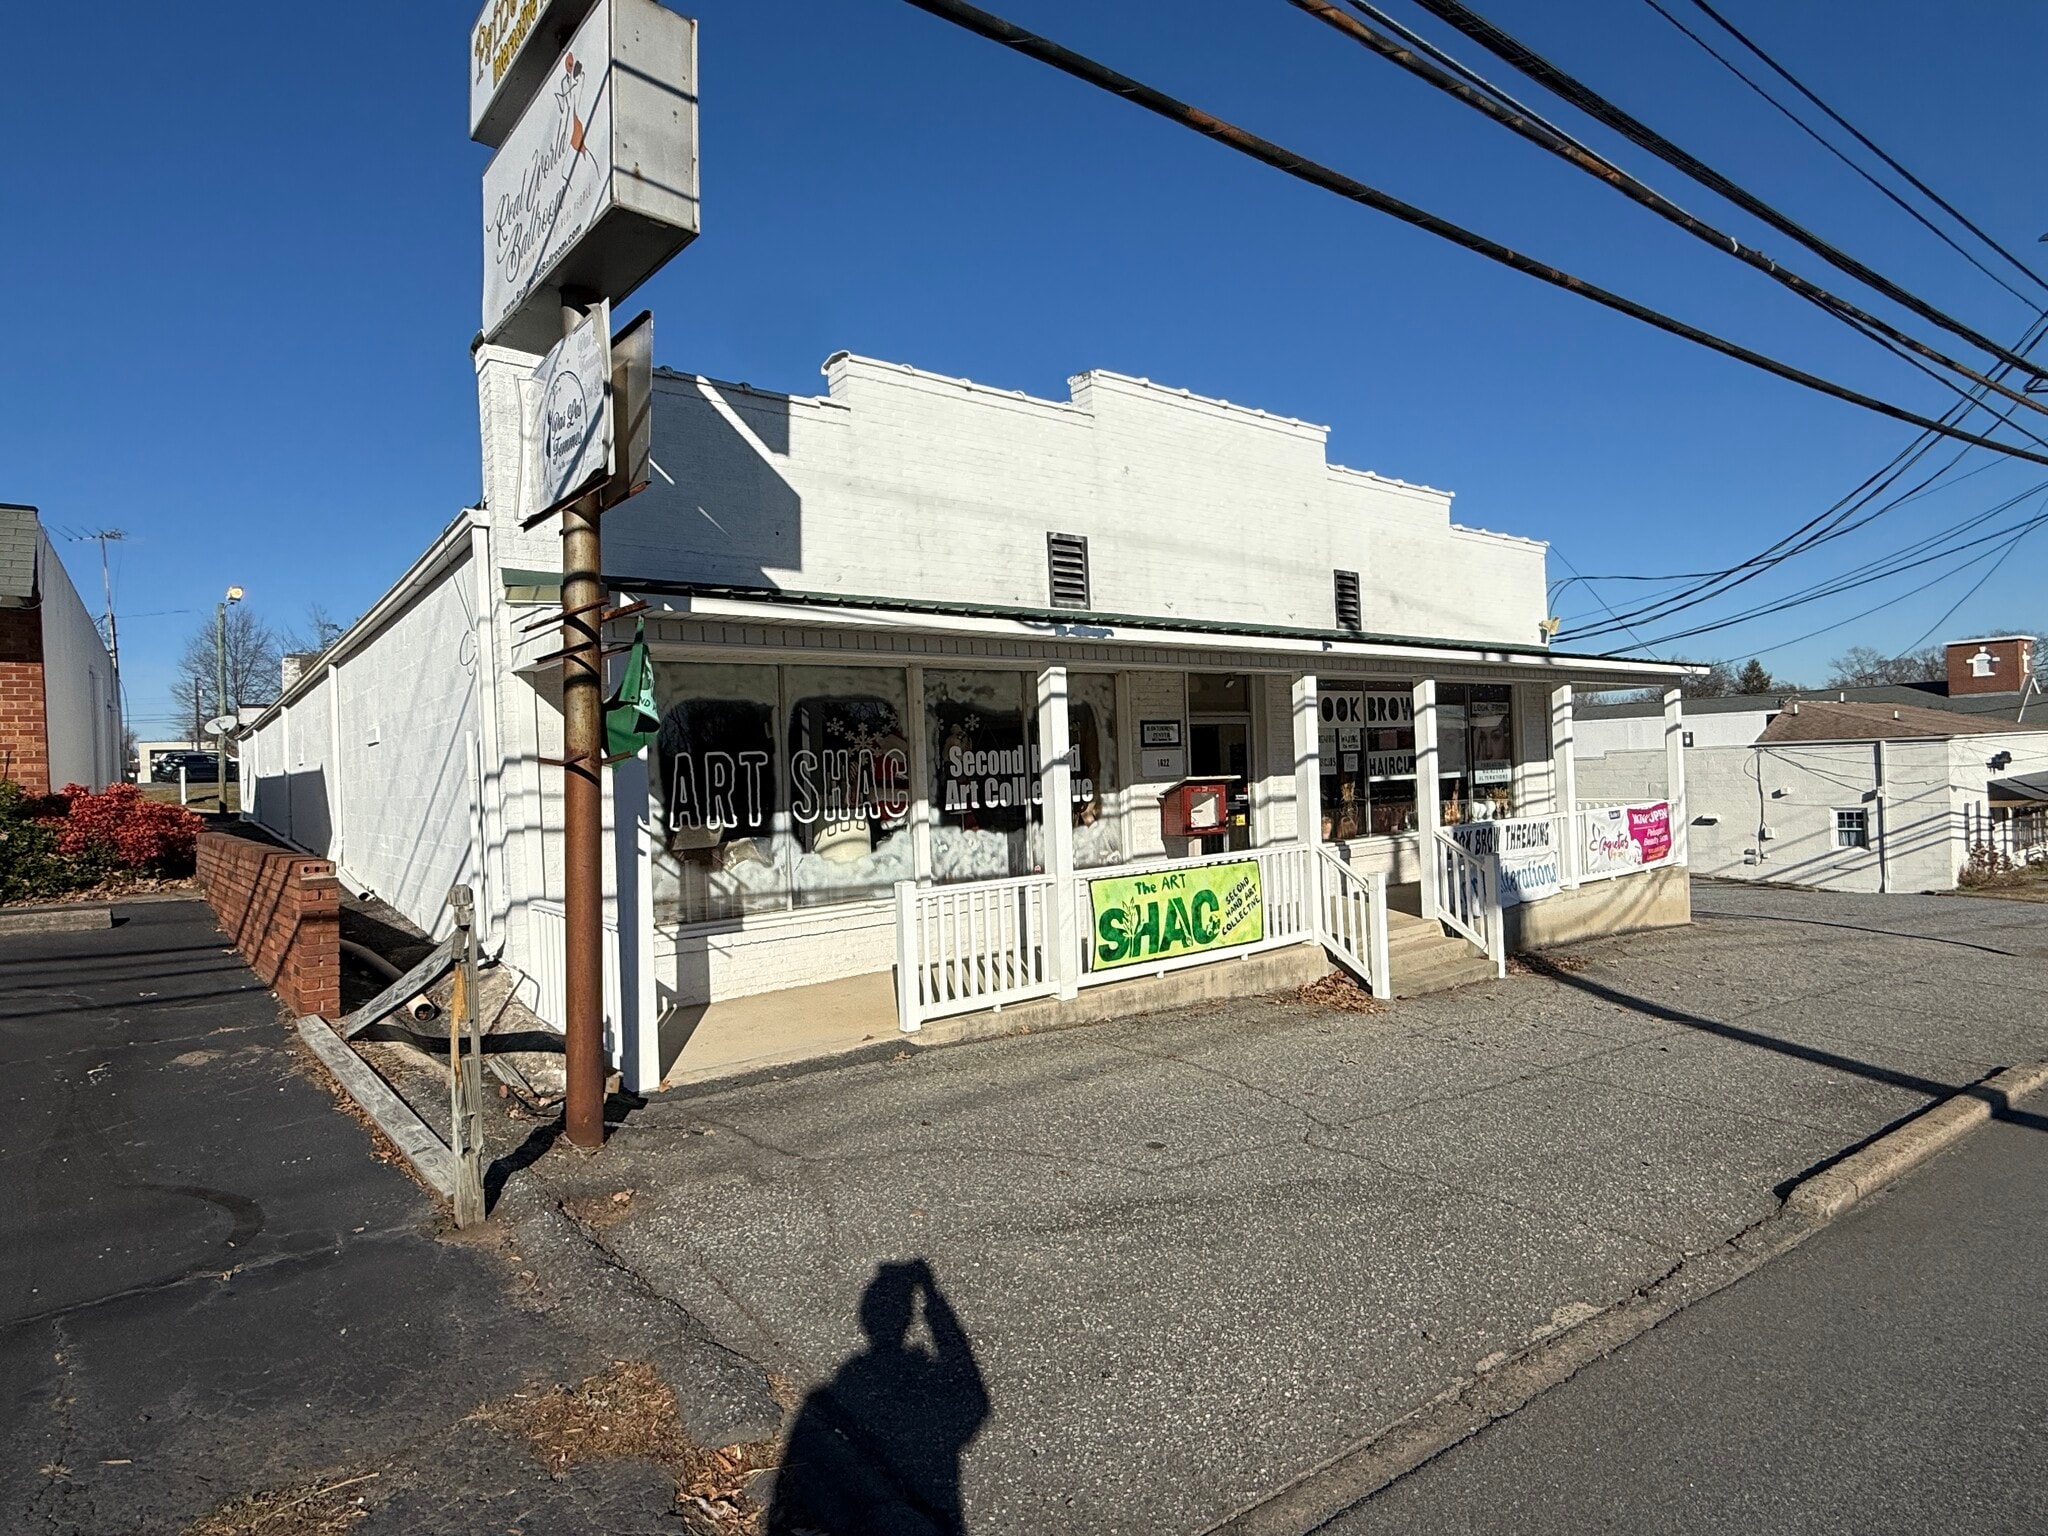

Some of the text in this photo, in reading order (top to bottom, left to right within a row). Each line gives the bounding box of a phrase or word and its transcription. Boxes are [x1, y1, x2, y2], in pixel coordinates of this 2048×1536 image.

[486, 169, 527, 248] Real
[526, 118, 567, 212] World
[497, 185, 567, 283] Ballroom
[1317, 697, 1413, 722] OOK BROW
[949, 744, 1081, 777] Second Hd
[1369, 756, 1416, 776] HAIRCU
[670, 749, 909, 832] ART SHAC
[945, 777, 1094, 811] Art Colleve
[1475, 826, 1500, 855] BROW
[1505, 822, 1549, 850] THREADING
[1134, 873, 1186, 895] The ART
[1225, 876, 1250, 905] SECOND
[1501, 860, 1557, 894] lterations
[1222, 895, 1261, 936] COLLECTIVE
[1225, 883, 1257, 917] HAND ART
[1098, 889, 1220, 962] SHAC
